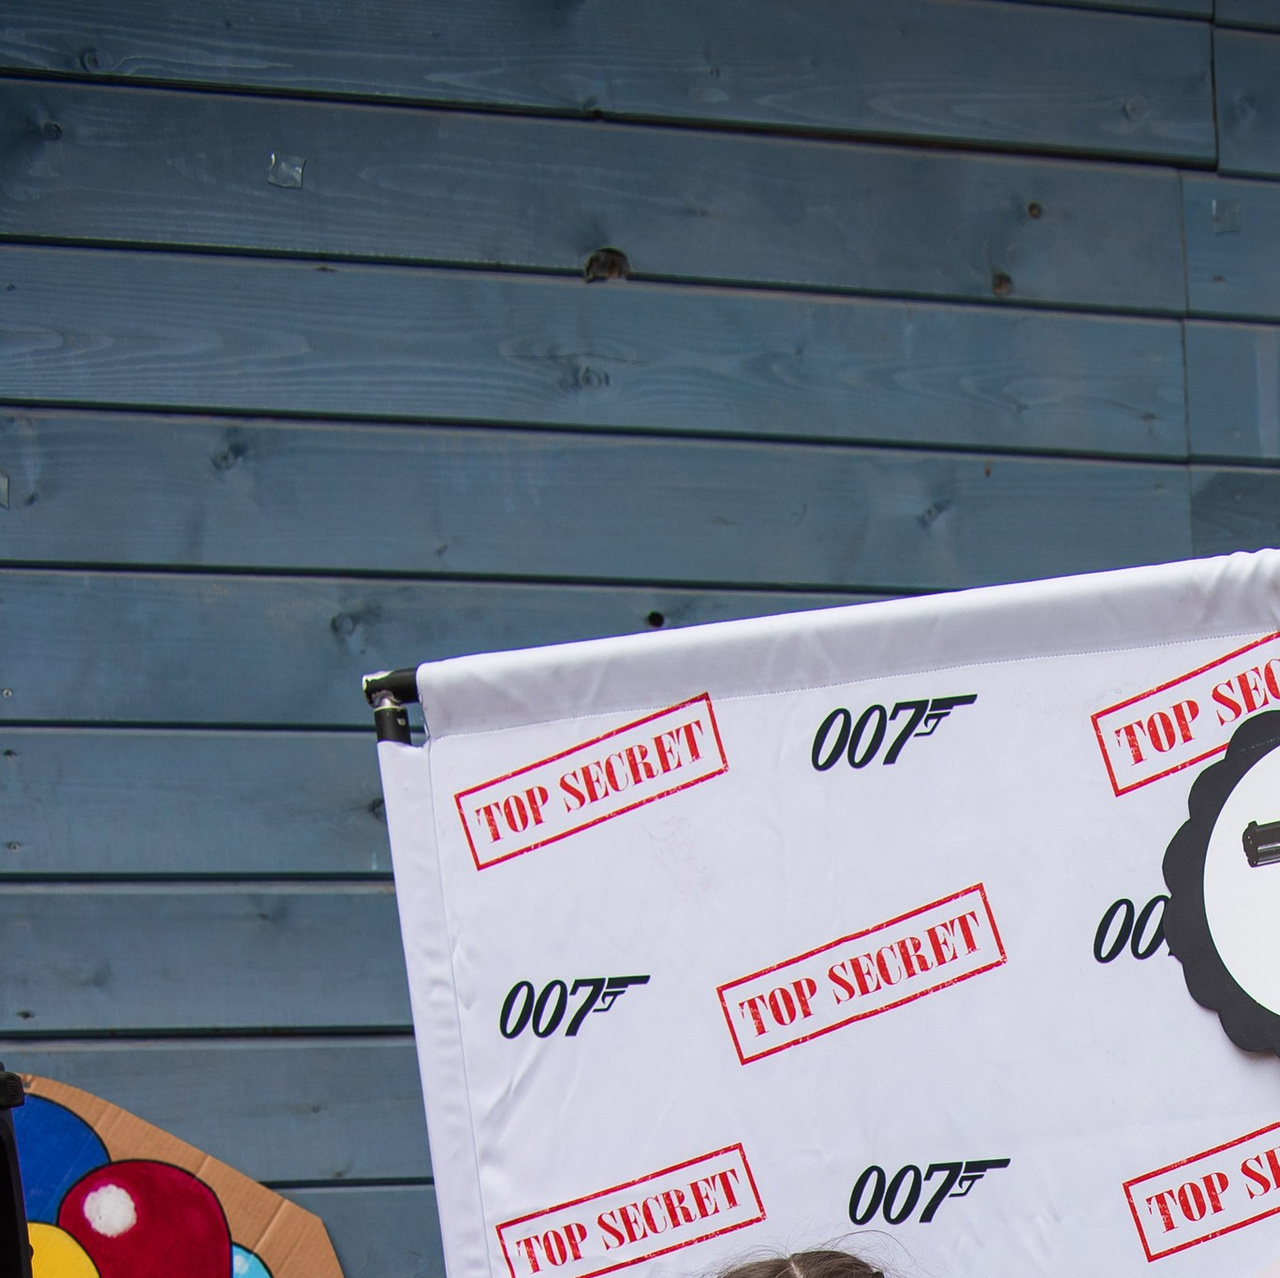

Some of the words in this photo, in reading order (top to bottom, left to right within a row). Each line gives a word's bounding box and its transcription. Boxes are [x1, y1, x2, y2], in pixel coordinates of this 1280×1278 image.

[811, 700, 930, 771] 007
[1114, 700, 1199, 765] TOP
[475, 786, 550, 843] TOP
[558, 720, 703, 812] SECRET
[1093, 895, 1170, 964] 00
[739, 977, 817, 1036] TOP
[828, 910, 980, 1001] SECRET
[499, 978, 606, 1039] 007
[515, 1222, 588, 1274] TOP
[597, 1168, 739, 1250] SECRET
[849, 1162, 963, 1226] 007
[1146, 1172, 1230, 1233] TOP
